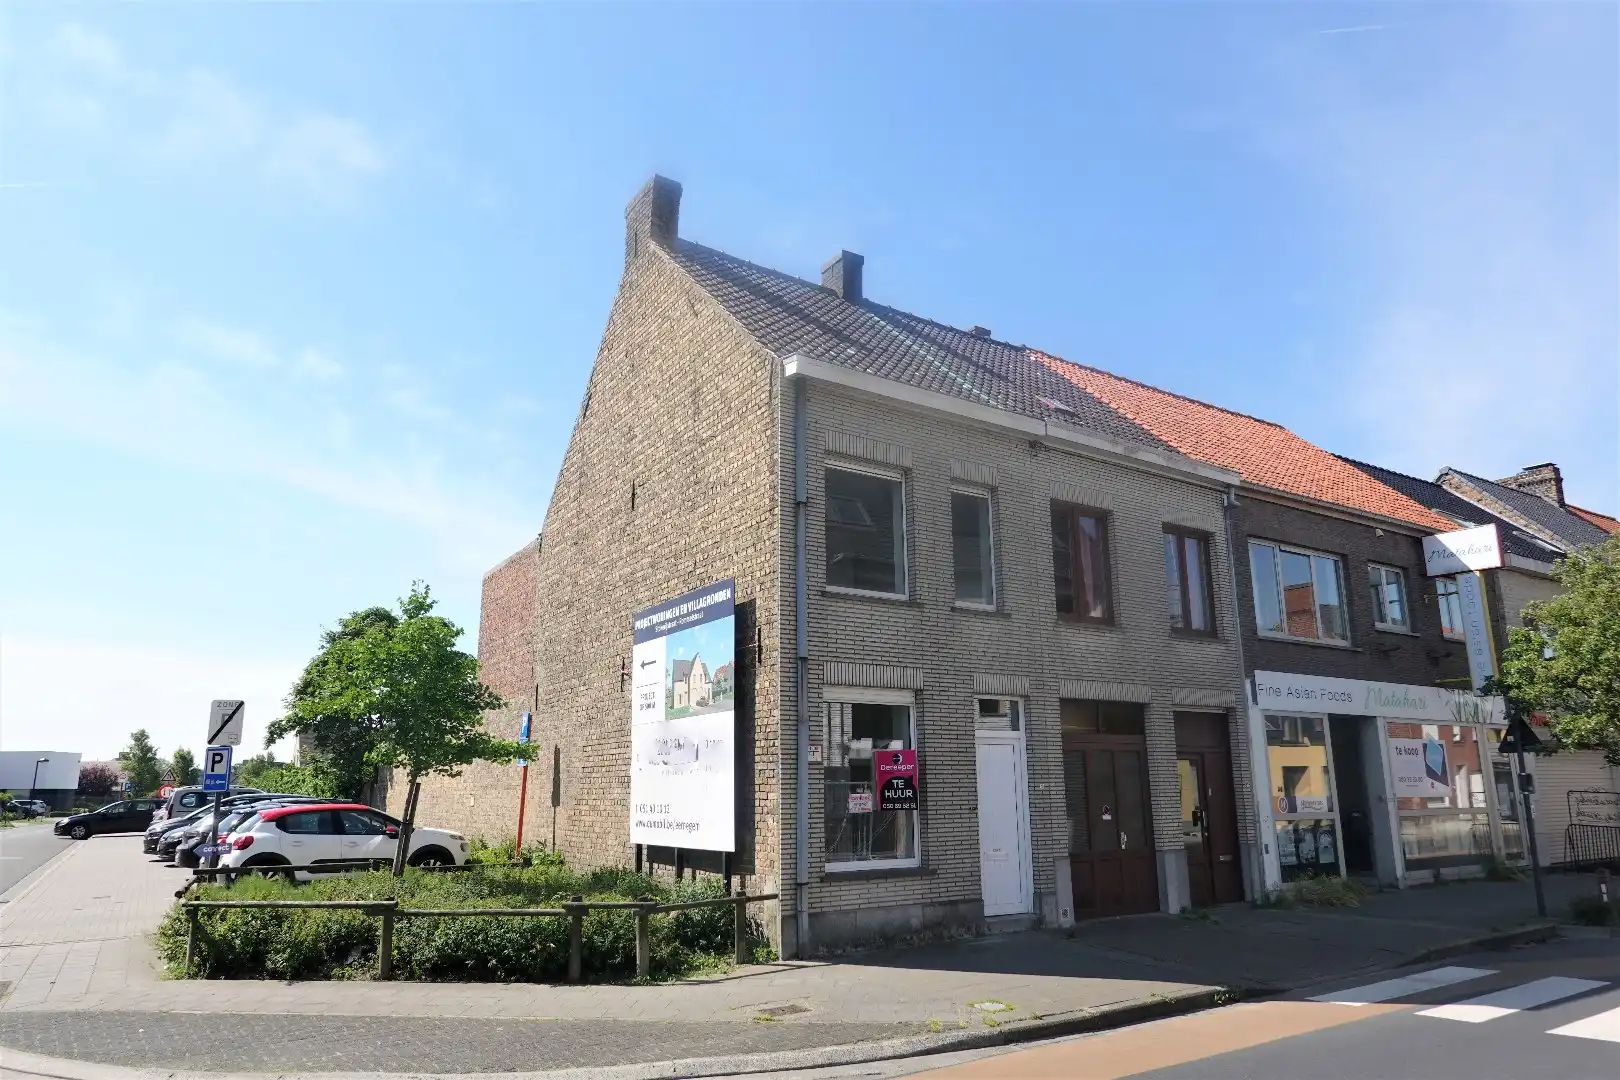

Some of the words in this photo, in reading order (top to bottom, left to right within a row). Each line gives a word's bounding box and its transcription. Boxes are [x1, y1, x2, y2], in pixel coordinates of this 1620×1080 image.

[1257, 684, 1282, 697] Fine
[1286, 686, 1317, 699] Asian
[1320, 688, 1353, 703] Foods
[1364, 685, 1428, 710] Matahari
[1395, 746, 1403, 756] te
[1403, 745, 1419, 758] koop
[211, 753, 223, 772] P
[892, 780, 905, 788] TE
[885, 790, 914, 798] HUUR
